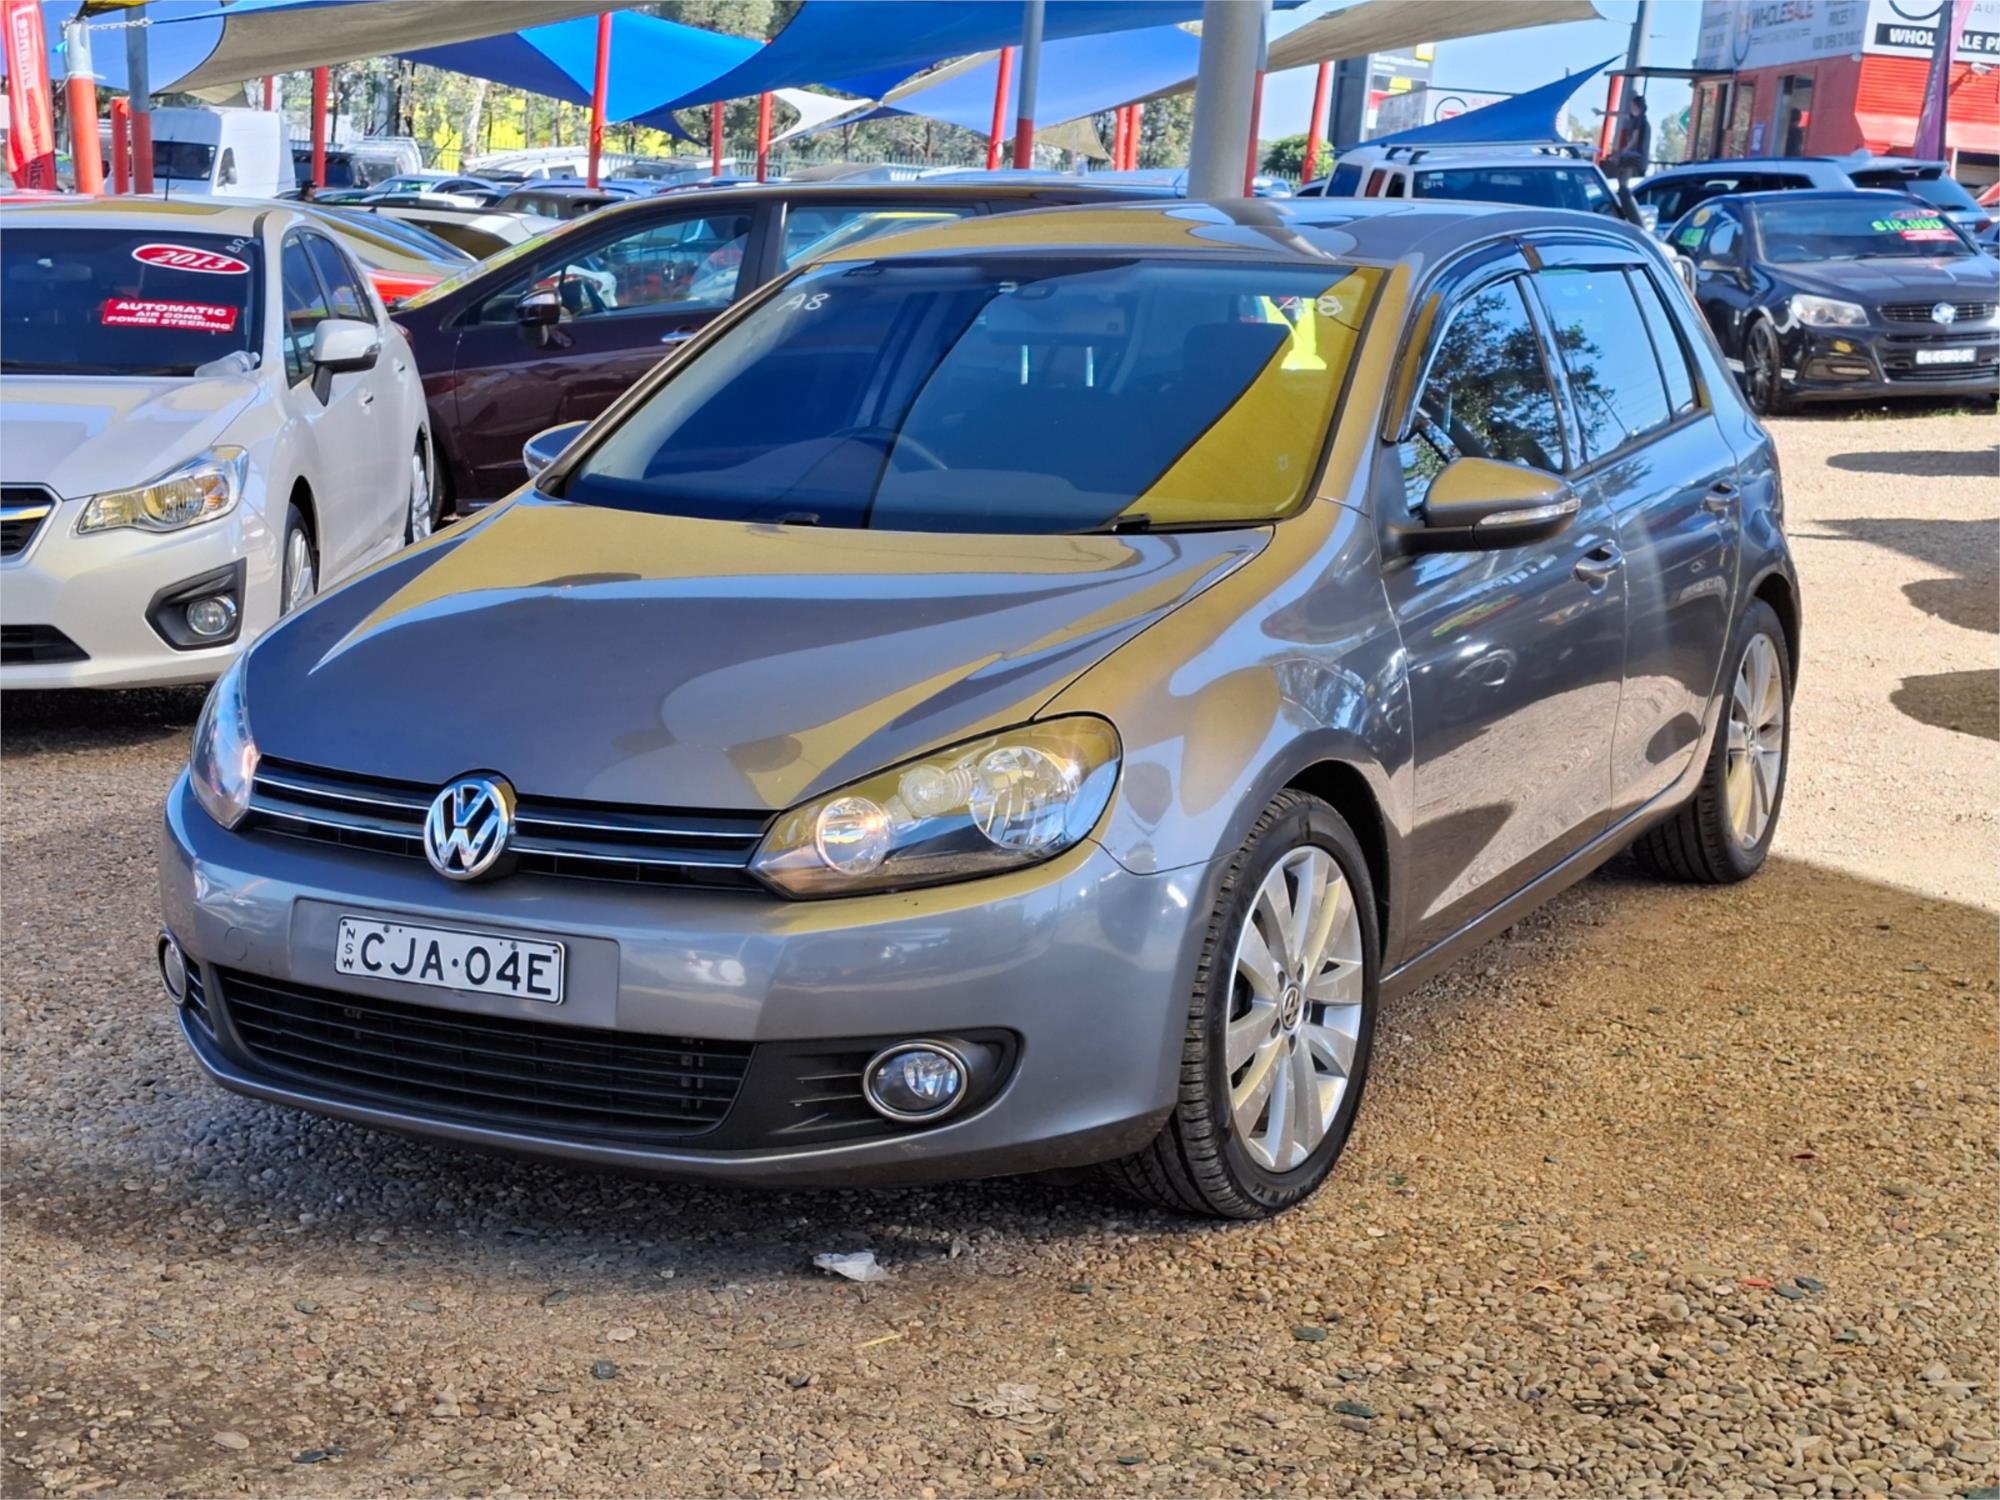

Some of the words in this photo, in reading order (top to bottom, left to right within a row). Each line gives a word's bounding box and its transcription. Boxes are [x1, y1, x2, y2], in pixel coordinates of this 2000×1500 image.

[149, 250, 233, 270] 2013
[116, 302, 227, 316] AUTOMATIC
[776, 292, 832, 312] A8
[107, 315, 157, 324] POWER
[160, 318, 231, 330] STEERING
[163, 312, 206, 321] COND.
